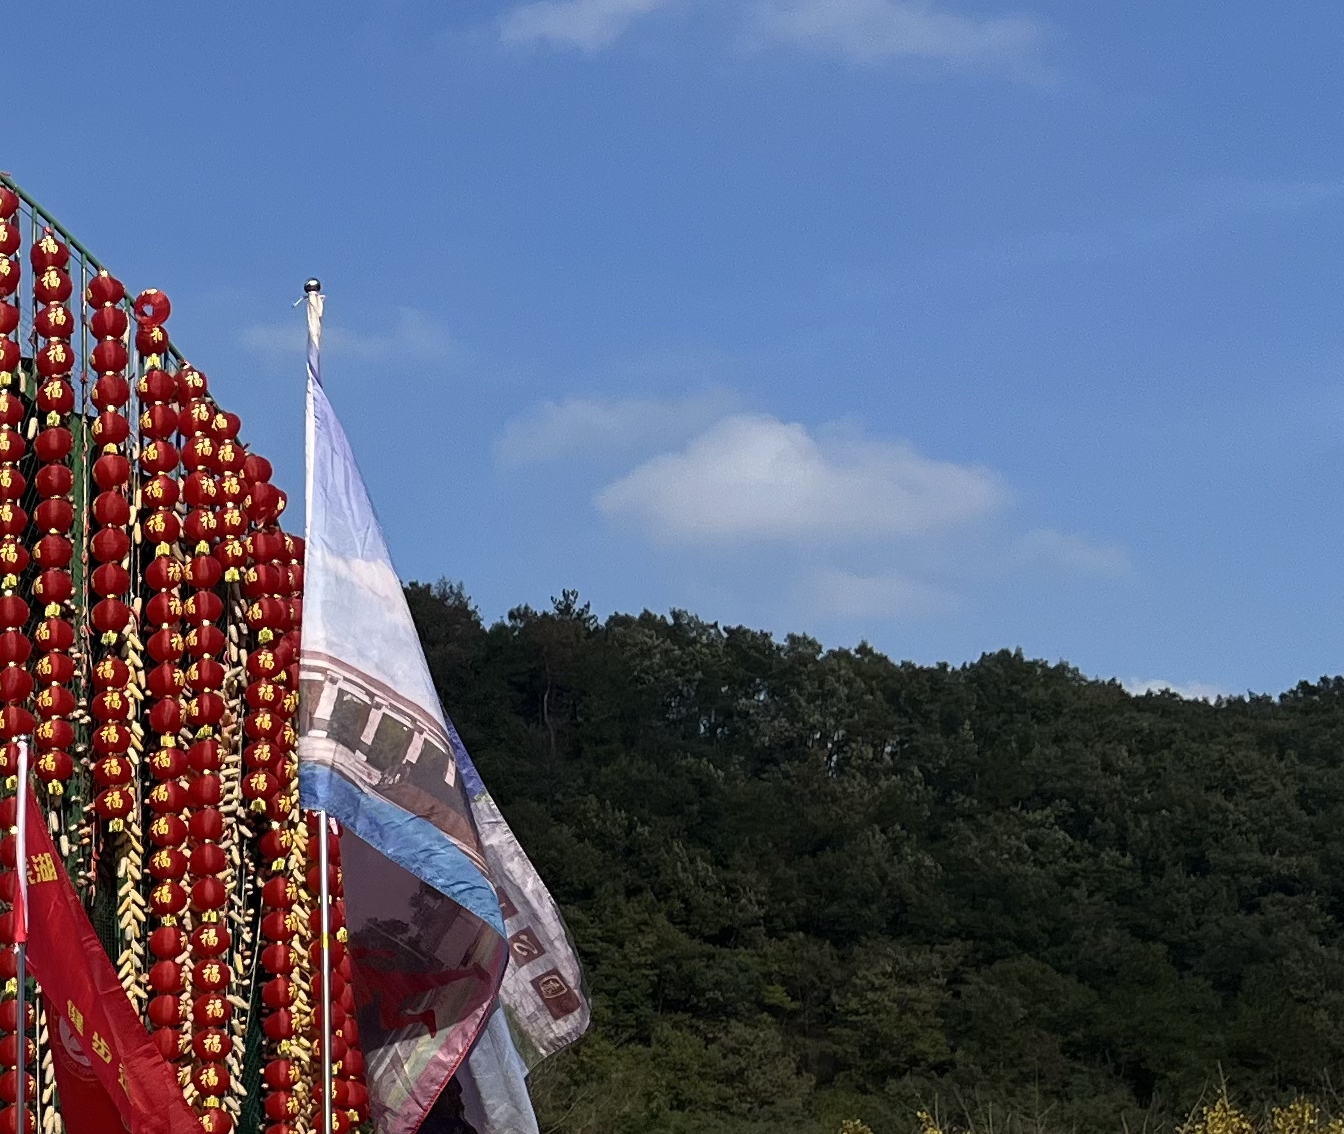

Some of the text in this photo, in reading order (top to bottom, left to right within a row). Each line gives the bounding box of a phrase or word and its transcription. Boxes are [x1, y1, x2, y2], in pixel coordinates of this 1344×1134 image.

[39, 237, 58, 254] 福
[42, 266, 60, 289] 福
[48, 307, 66, 326] 福
[48, 342, 65, 363] 福
[44, 380, 62, 400] 福
[185, 372, 203, 388] 福
[191, 404, 209, 421] 福
[195, 435, 212, 456] 福
[218, 439, 234, 462] 福
[145, 479, 164, 498] 福
[200, 476, 216, 497] 福
[222, 471, 240, 494] 福
[147, 513, 165, 533] 福
[200, 511, 217, 529] 福
[0, 543, 17, 563] 福
[225, 535, 242, 557] 福
[97, 658, 114, 679] 福
[258, 650, 274, 670] 福
[103, 686, 122, 709] 福
[258, 683, 274, 701] 福
[37, 721, 56, 738] 福
[255, 709, 272, 730] 福
[100, 722, 119, 743] 福
[38, 748, 58, 771] 福
[151, 750, 171, 768] 福
[254, 745, 270, 761] 福
[103, 758, 121, 776] 福
[250, 771, 267, 791] 福
[104, 791, 123, 810] 福
[150, 784, 170, 802] 福
[152, 817, 168, 836] 福
[153, 846, 172, 869] 福
[154, 882, 171, 903] 福
[200, 926, 218, 946] 福
[202, 964, 220, 983] 福
[205, 999, 224, 1018] 福
[203, 1032, 221, 1053] 福
[200, 1068, 218, 1086] 福
